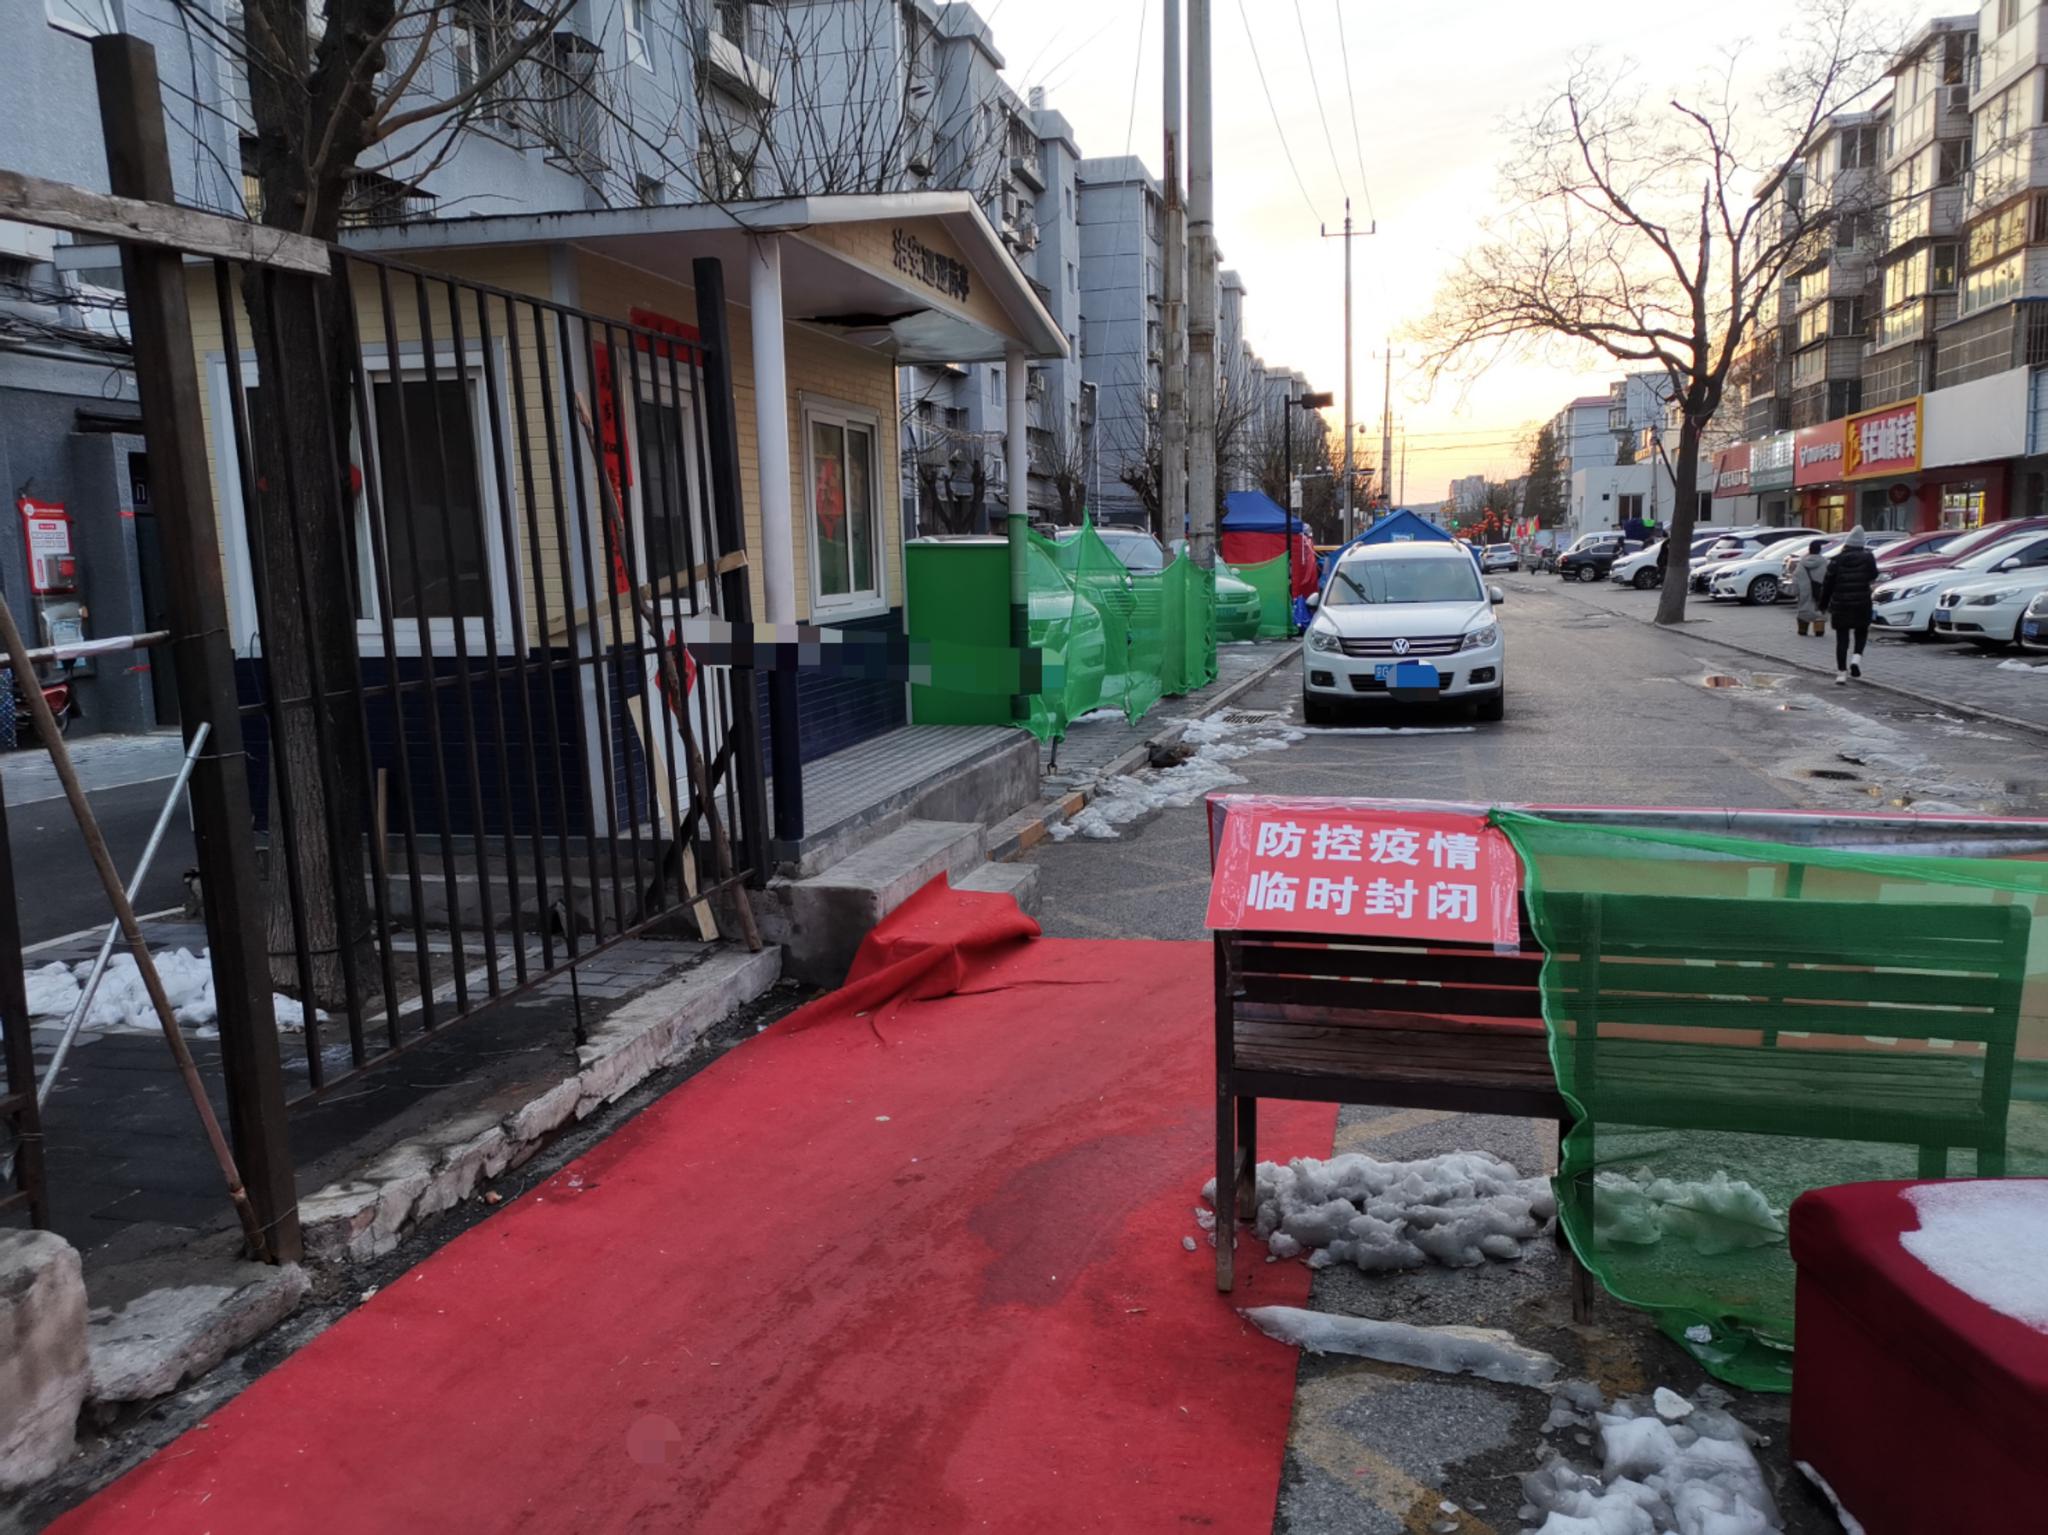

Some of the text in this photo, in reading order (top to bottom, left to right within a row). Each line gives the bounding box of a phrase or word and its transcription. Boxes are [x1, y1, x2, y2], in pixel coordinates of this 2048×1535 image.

[1255, 821, 1480, 870] 防控疫情
[1247, 871, 1478, 922] 临时封闭
